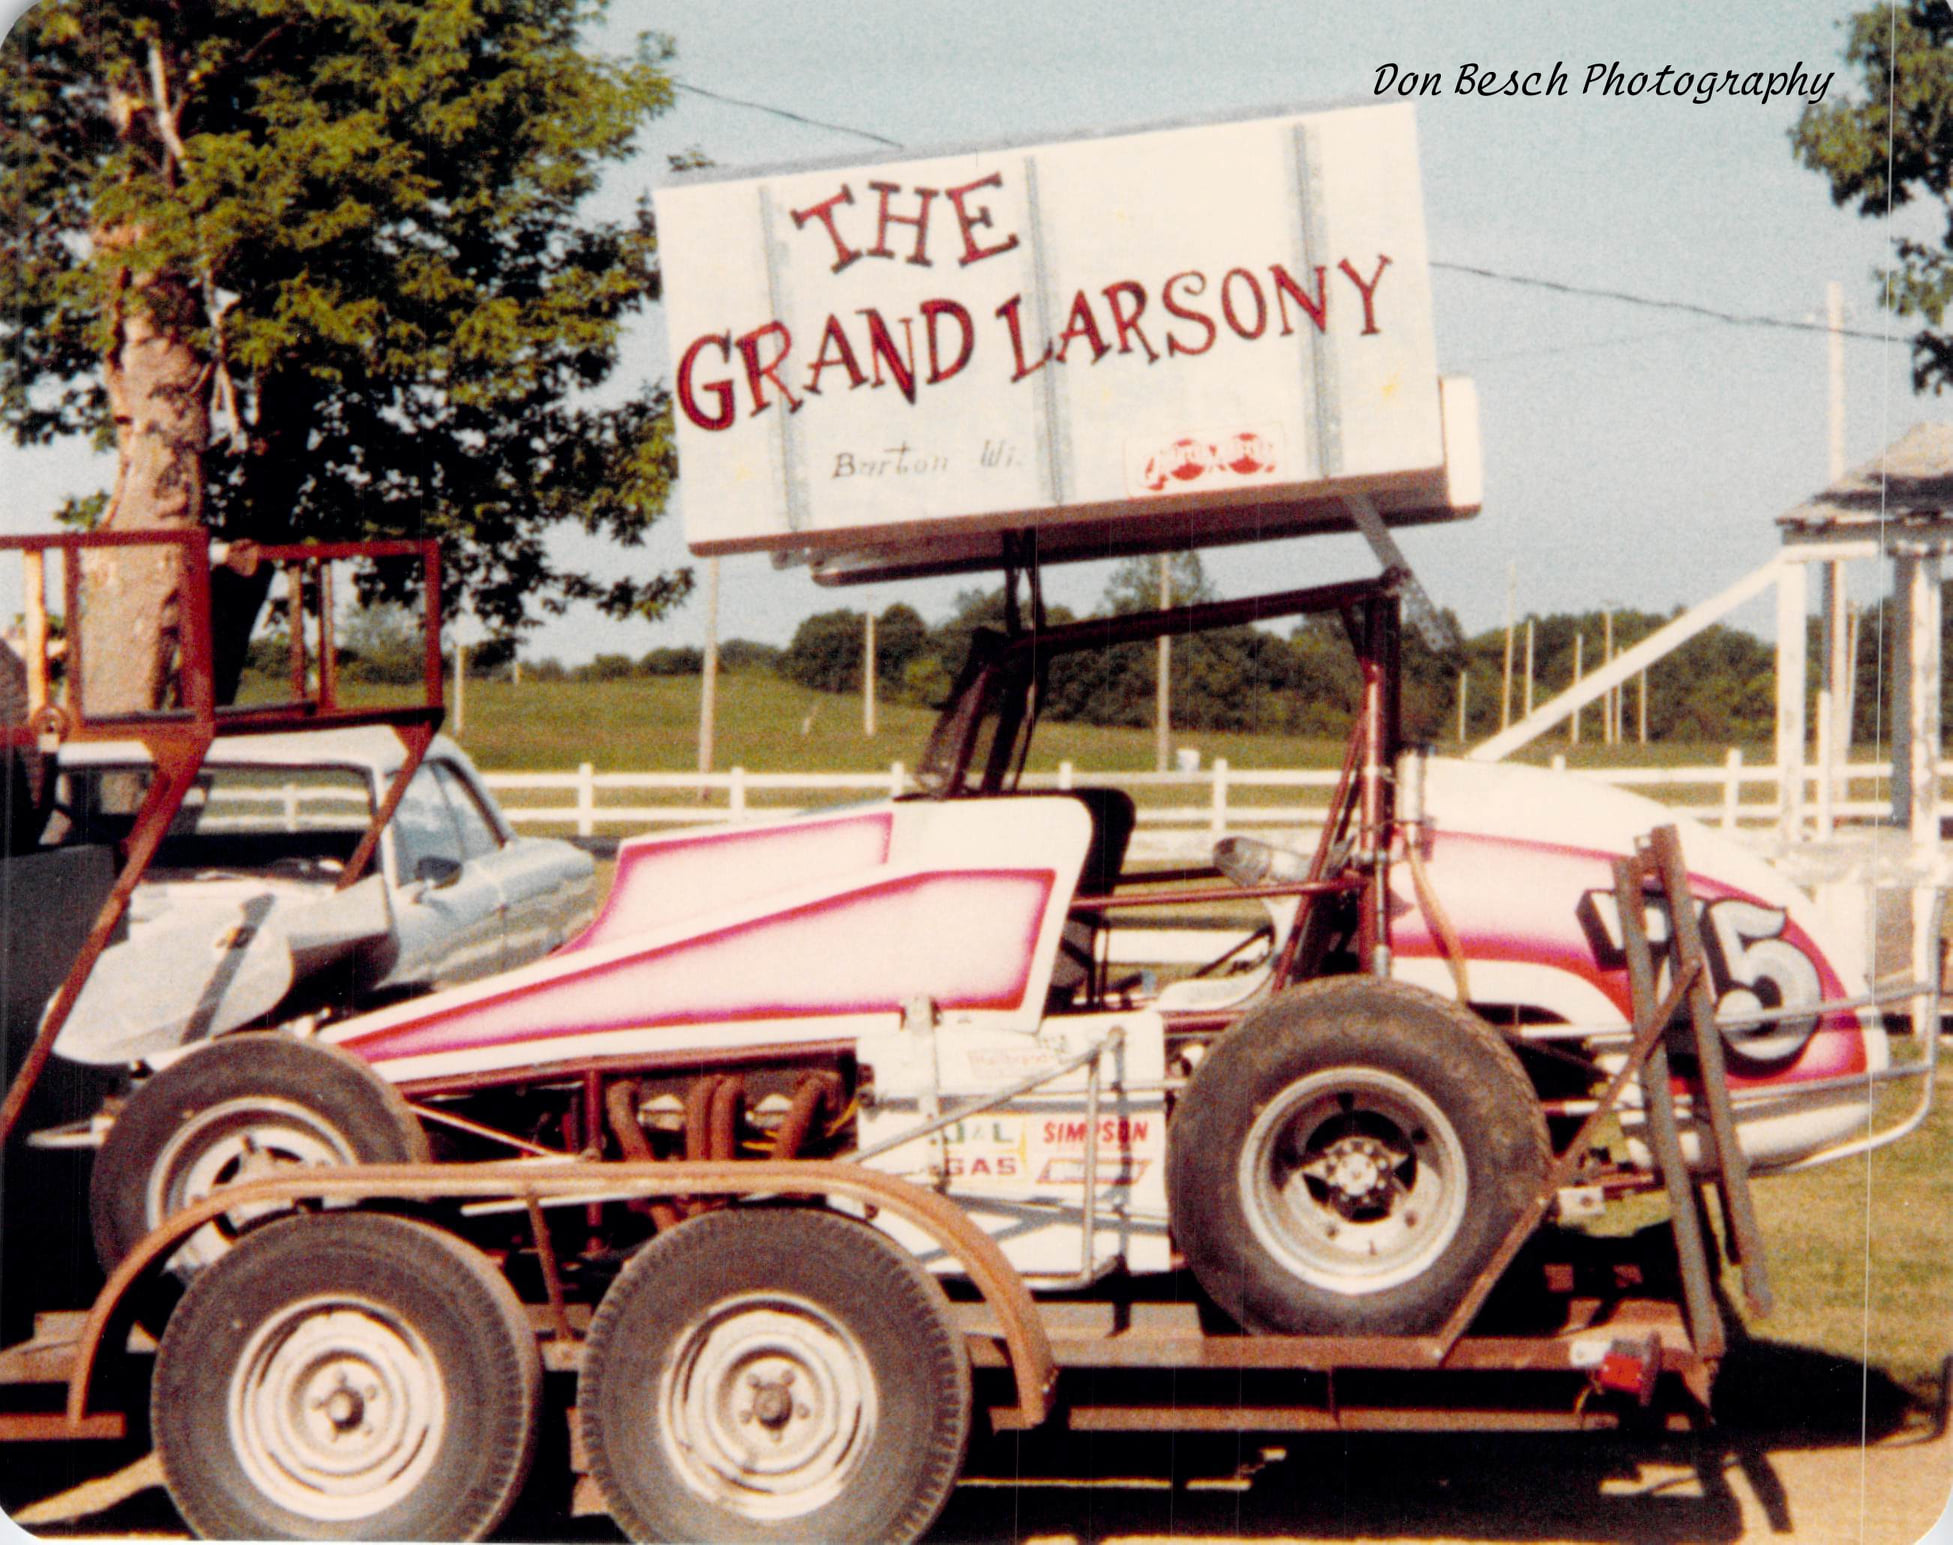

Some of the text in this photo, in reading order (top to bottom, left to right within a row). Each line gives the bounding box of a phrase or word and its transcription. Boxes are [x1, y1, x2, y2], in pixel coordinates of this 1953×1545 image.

[792, 172, 1020, 273] THE
[676, 254, 1393, 432] GRAND LARSONY
[946, 1157, 1017, 1177] GAS
